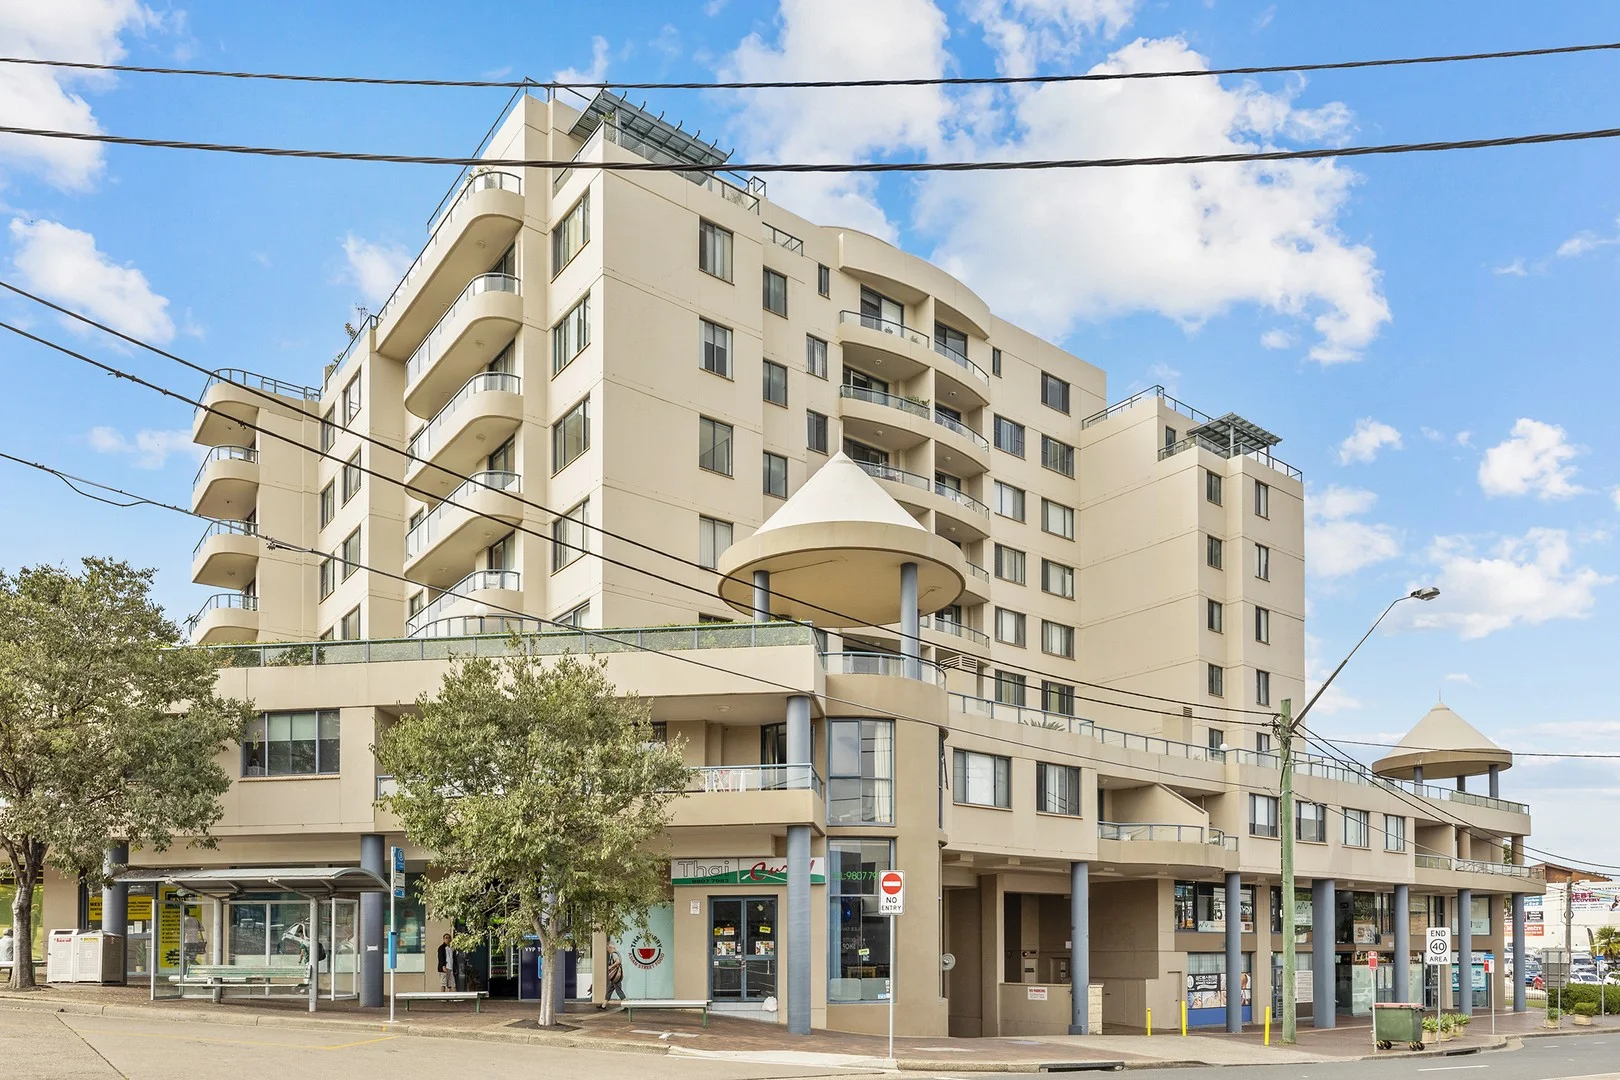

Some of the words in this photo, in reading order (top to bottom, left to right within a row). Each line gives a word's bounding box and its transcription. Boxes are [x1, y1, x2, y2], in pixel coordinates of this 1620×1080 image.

[678, 861, 730, 877] Thai
[886, 896, 898, 904] NO
[1432, 942, 1445, 951] 40
